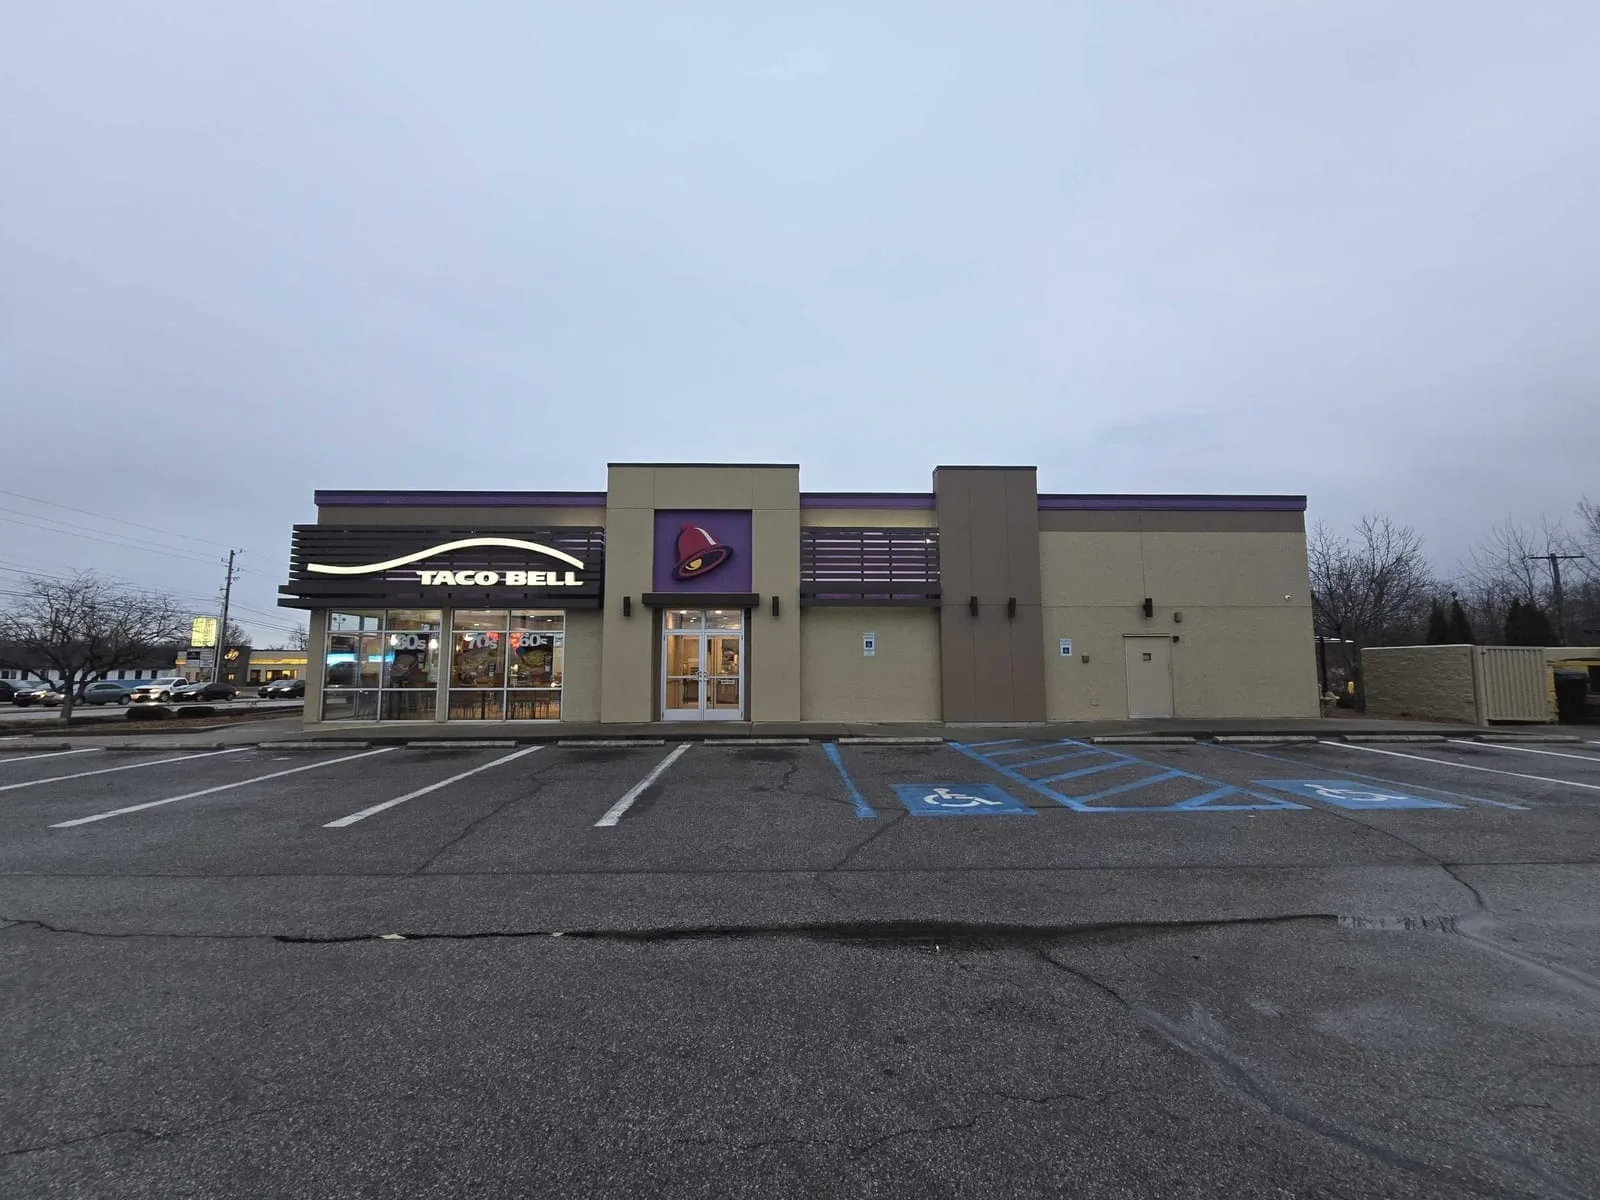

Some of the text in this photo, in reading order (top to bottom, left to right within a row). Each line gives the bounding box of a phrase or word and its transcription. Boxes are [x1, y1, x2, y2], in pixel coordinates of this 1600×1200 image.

[416, 570, 584, 586] TACO BELL
[464, 632, 498, 650] 70s
[520, 632, 548, 647] 60s
